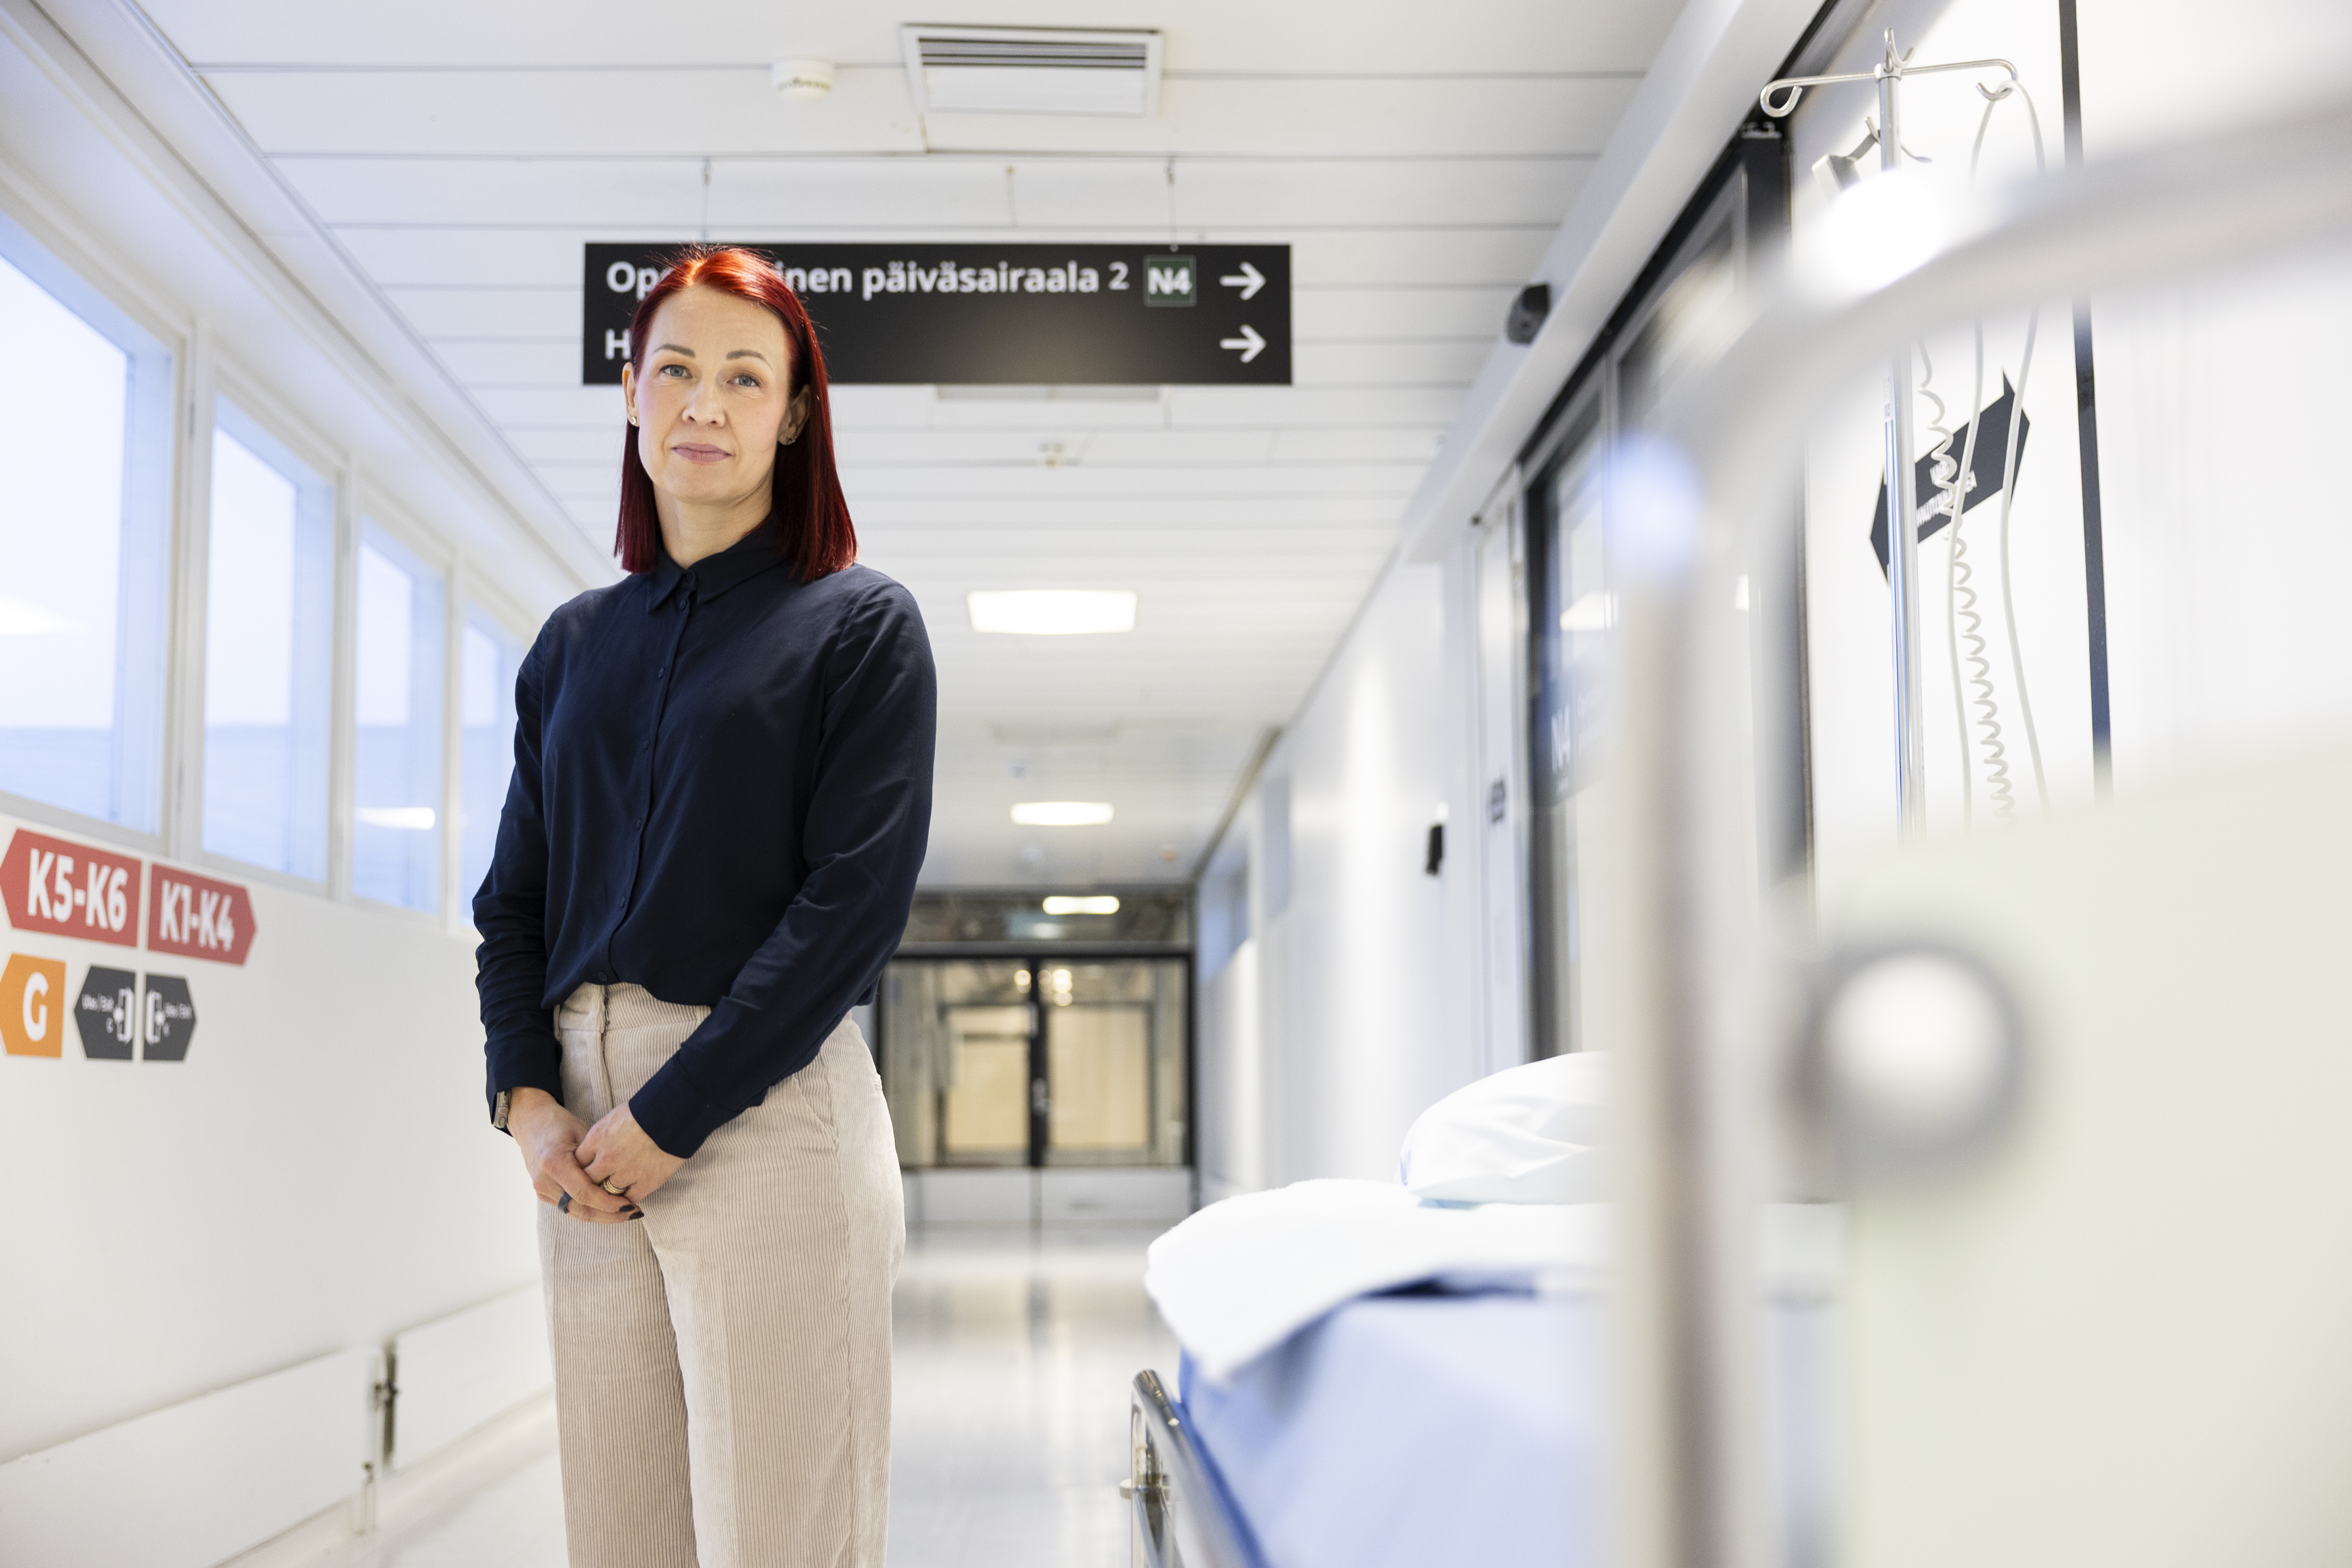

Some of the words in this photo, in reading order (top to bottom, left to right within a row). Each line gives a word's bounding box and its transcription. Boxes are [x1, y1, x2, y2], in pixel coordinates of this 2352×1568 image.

[863, 260, 1099, 301] päiväsairaala
[1109, 261, 1129, 290] 2
[1148, 267, 1192, 295] N4
[28, 847, 129, 932] K5-K6
[160, 879, 235, 952] K1-K4
[23, 972, 48, 1042] G
